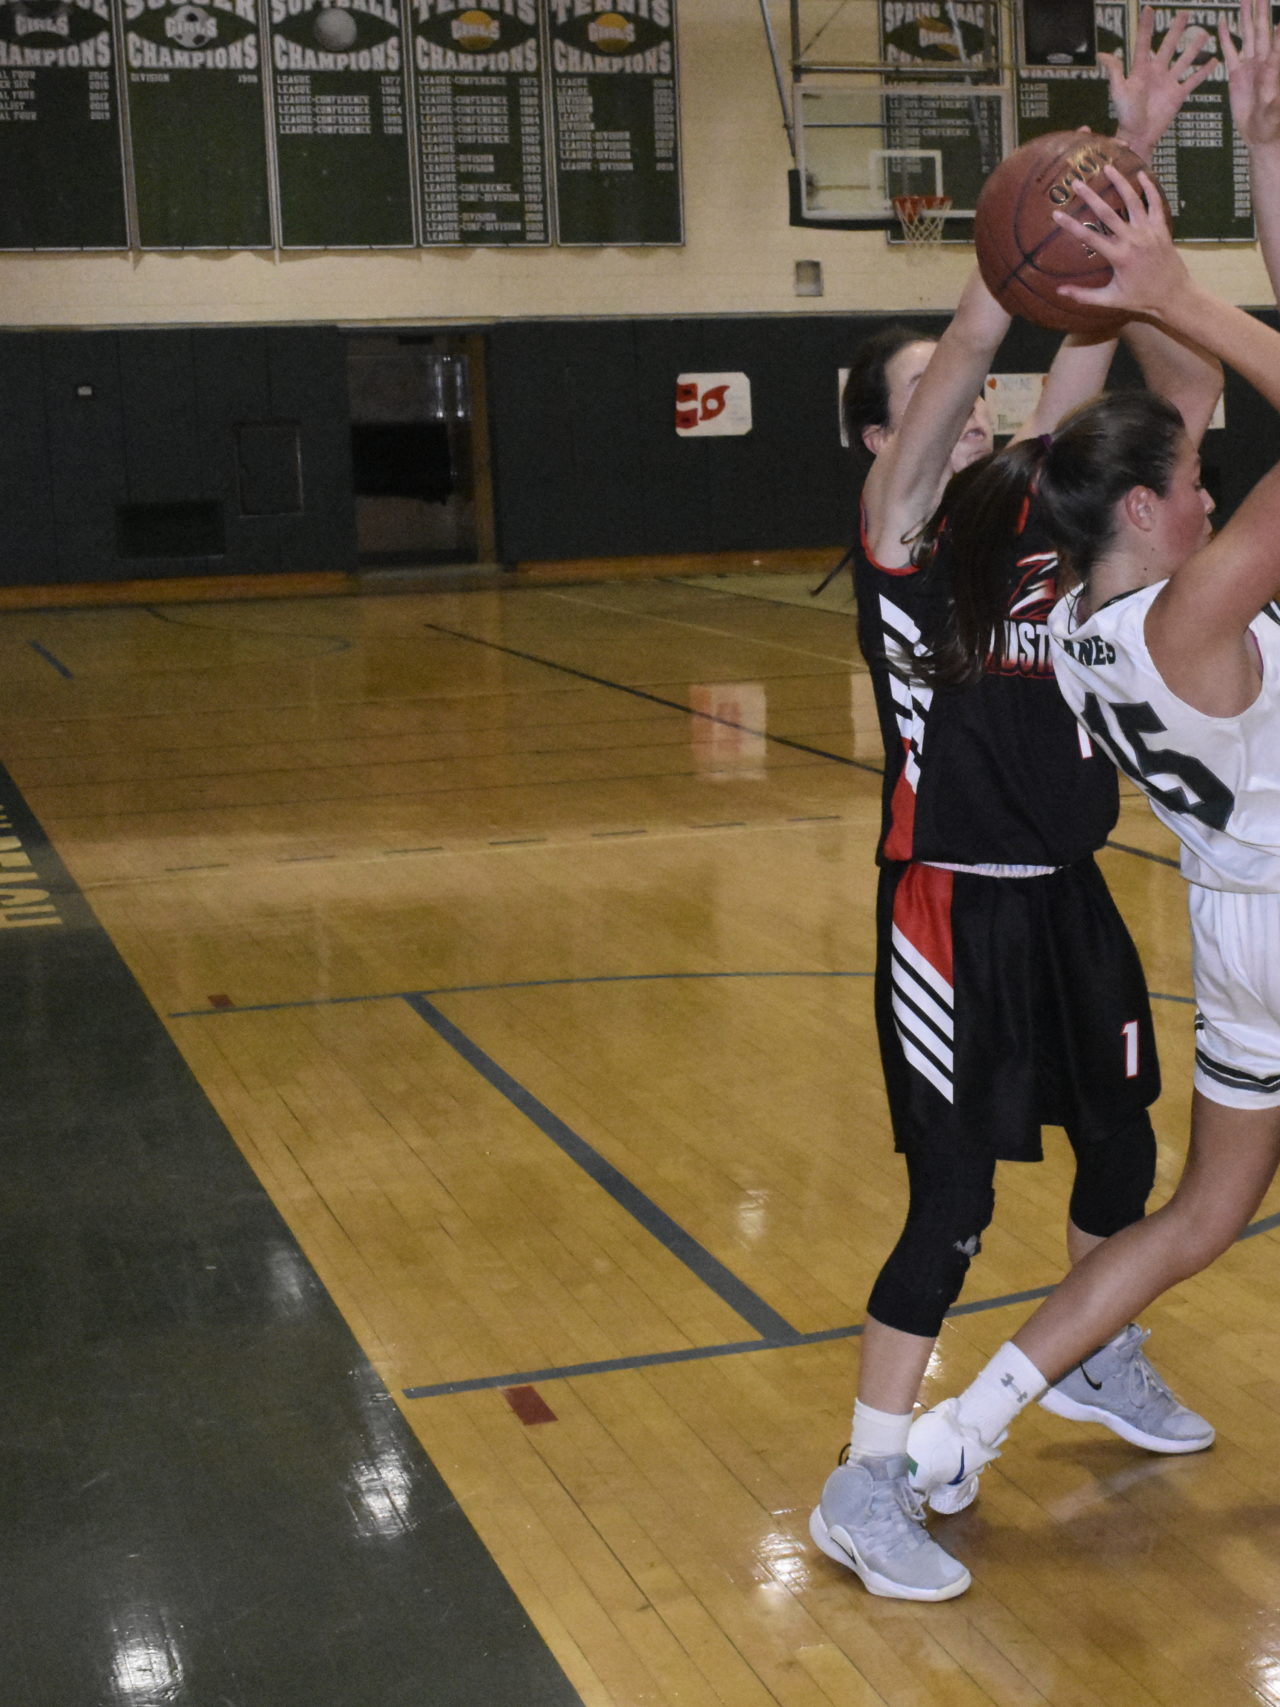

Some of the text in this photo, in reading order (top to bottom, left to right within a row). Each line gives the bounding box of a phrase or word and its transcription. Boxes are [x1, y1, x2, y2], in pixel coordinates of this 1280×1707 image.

[885, 1, 941, 33] SPRING
[127, 31, 258, 69] CHAMPIONS
[273, 33, 399, 71] CHAMPIONS
[416, 35, 537, 72] CHAMPIONS
[553, 38, 670, 74] CHAMPIONS
[277, 75, 310, 83] LEAGUE
[556, 78, 588, 86] LEAGUE
[278, 85, 311, 93] LEAGUE
[420, 86, 451, 94] LEAGUE
[422, 144, 454, 152] LEAGUE
[424, 174, 456, 182] LEAGUE
[425, 203, 458, 211] LEAGUE
[427, 232, 460, 240] LEAGUE
[1080, 691, 1236, 827] 15
[1121, 1020, 1139, 1079] 1
